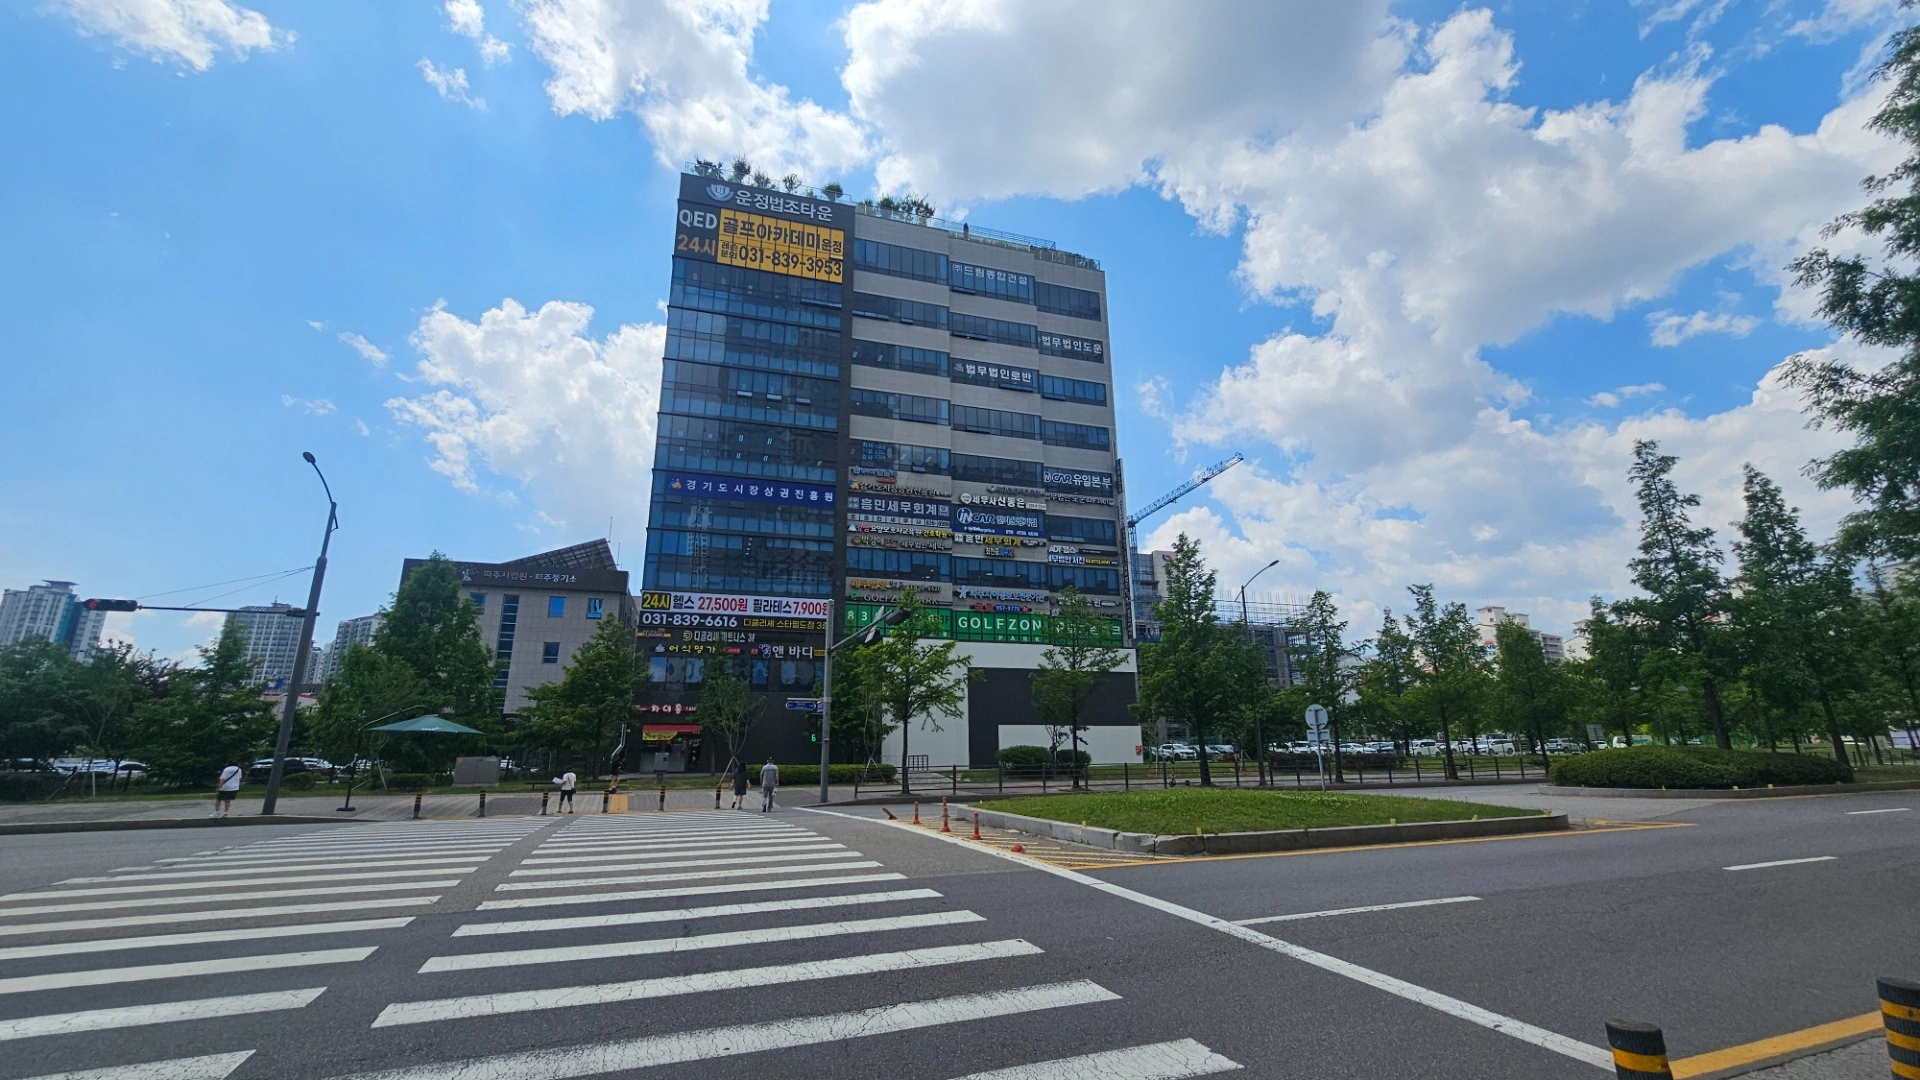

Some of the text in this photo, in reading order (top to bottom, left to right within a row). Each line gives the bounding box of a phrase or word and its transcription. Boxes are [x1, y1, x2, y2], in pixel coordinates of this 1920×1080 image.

[735, 189, 833, 222] 운정법조타운
[678, 209, 717, 230] QED
[722, 216, 842, 253] 골프아카데미 운정
[739, 245, 842, 277] 031-839-3953
[686, 479, 833, 502] 경기도시장상권진흥원
[1072, 473, 1112, 489] 유일본부
[860, 498, 937, 516] 흥민세무회계
[484, 570, 577, 583] 파주시법원 파주등기소
[642, 593, 670, 609] 24시
[673, 594, 694, 610] 헬스
[697, 596, 748, 612] 27,500원
[753, 599, 792, 614] 필라테스
[642, 613, 738, 628] 031-839-6616
[958, 616, 1042, 631] GOLFZON
